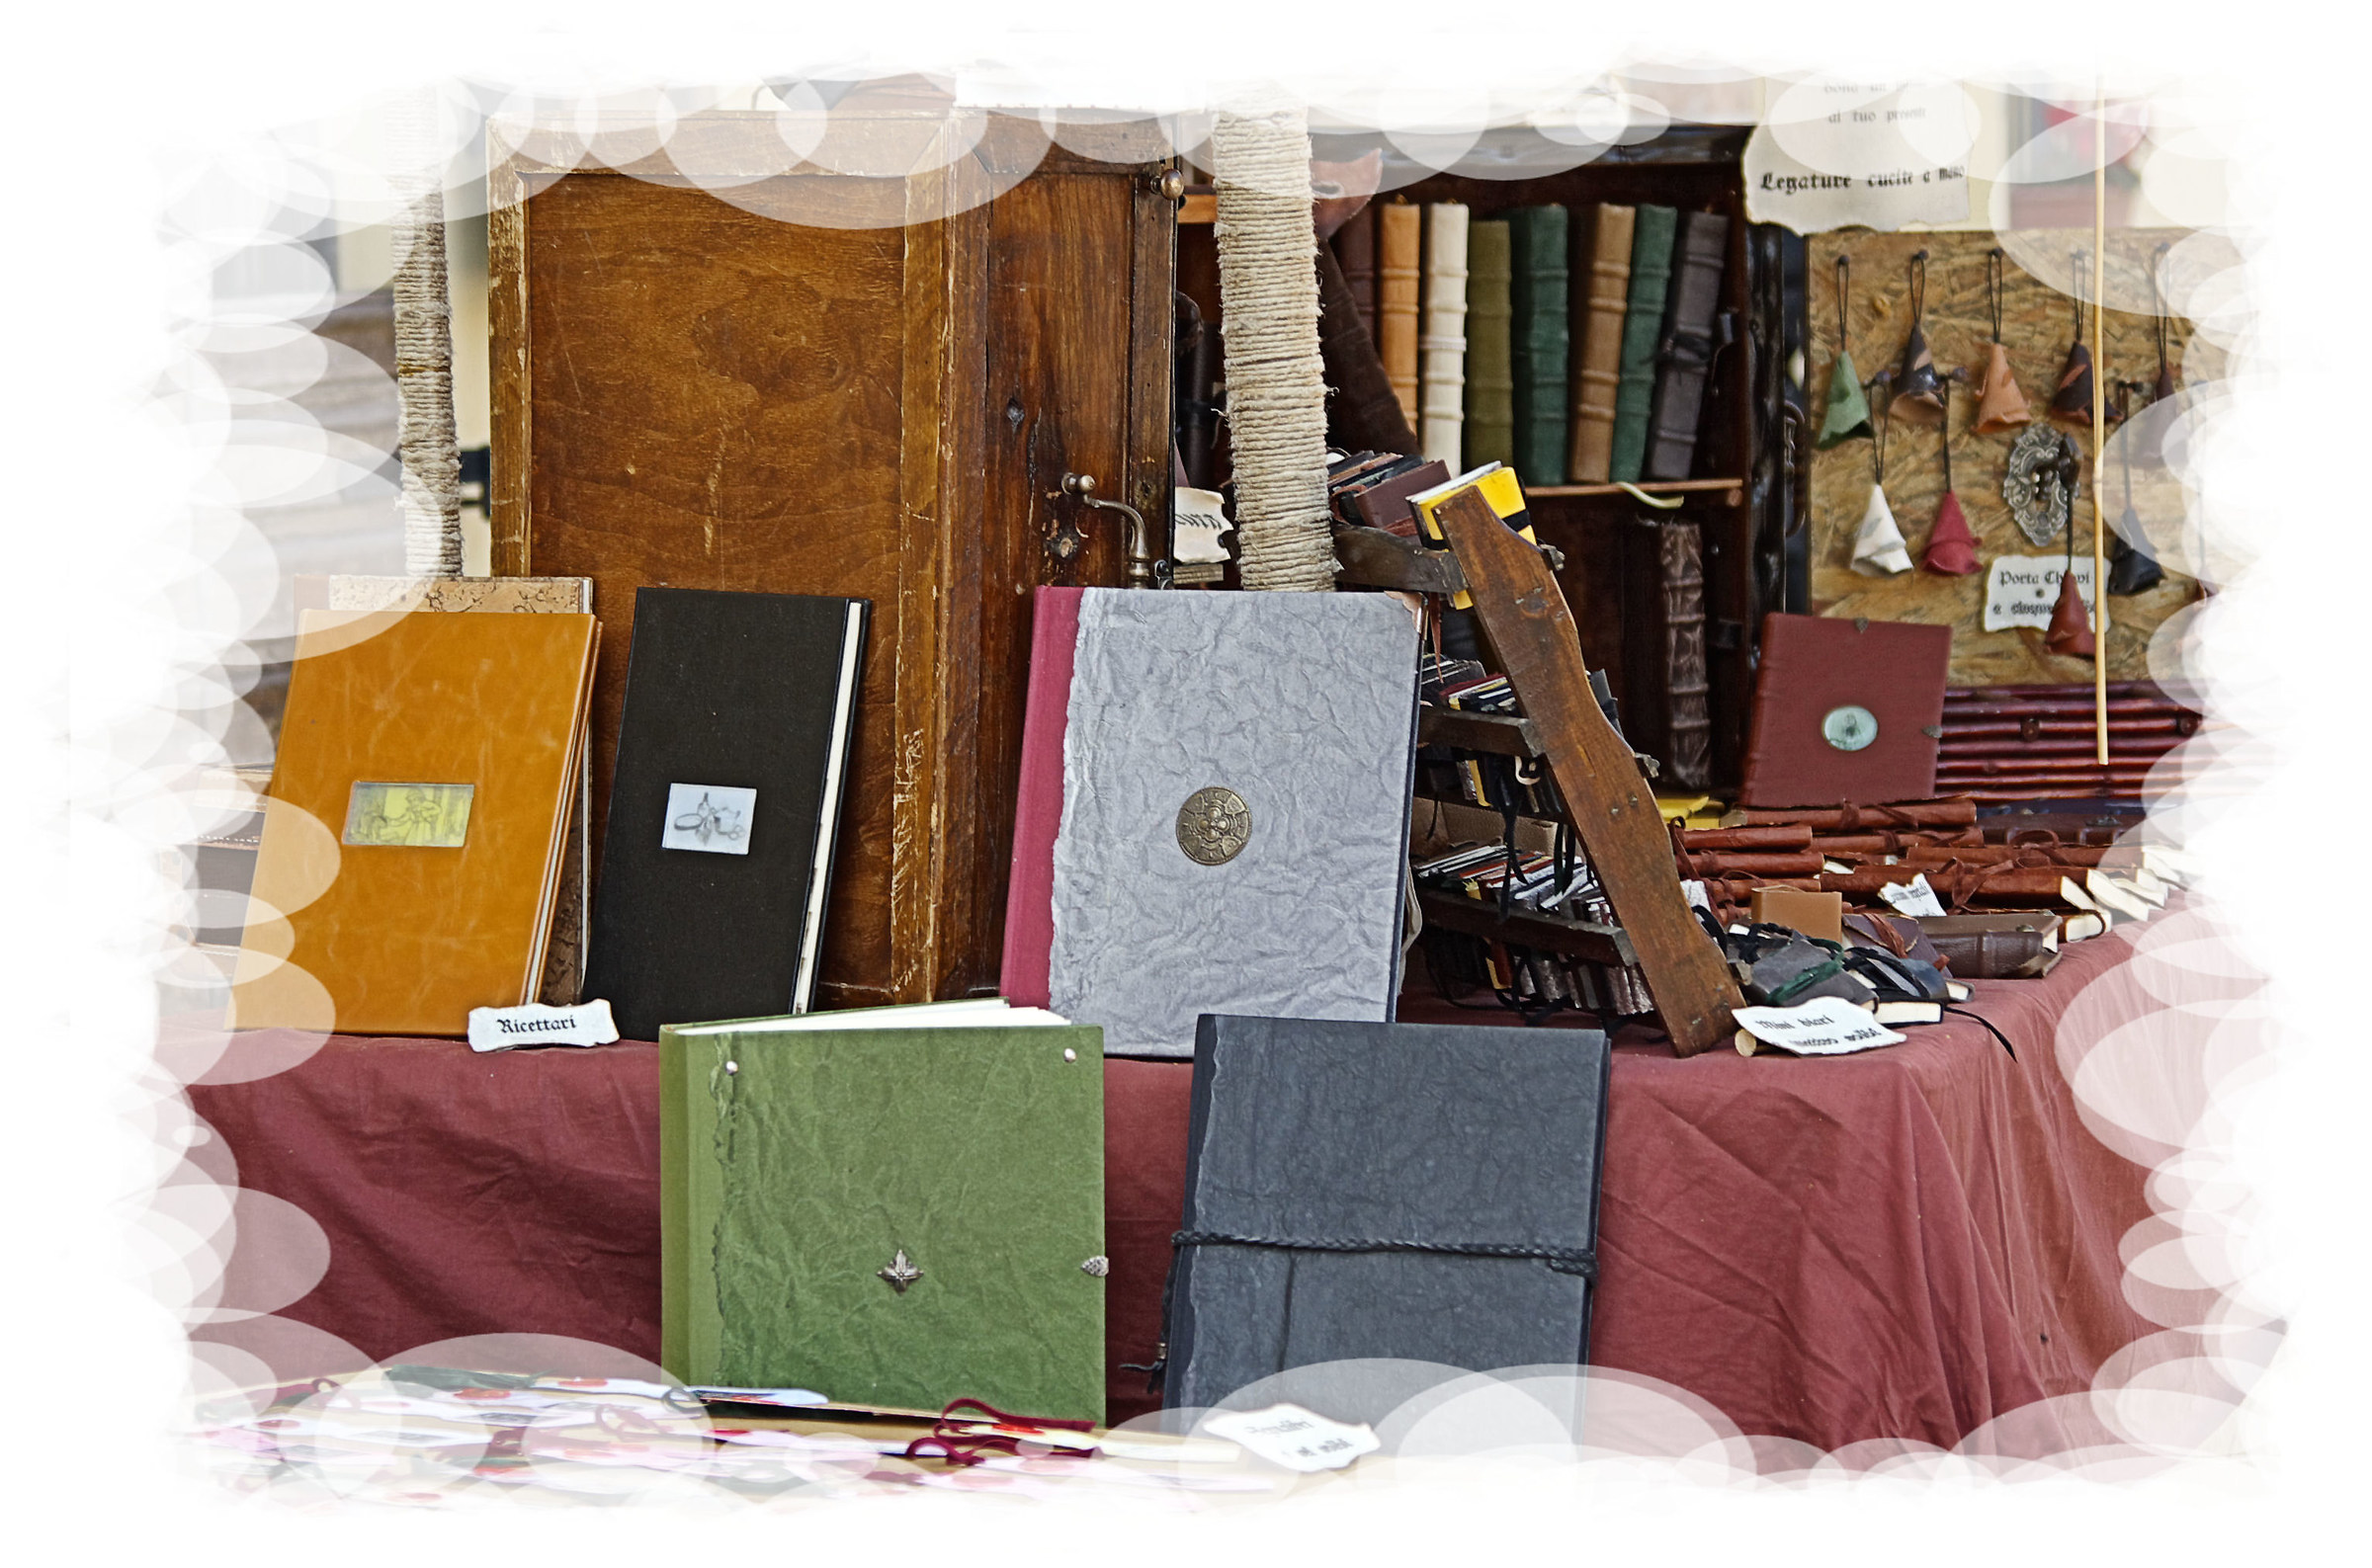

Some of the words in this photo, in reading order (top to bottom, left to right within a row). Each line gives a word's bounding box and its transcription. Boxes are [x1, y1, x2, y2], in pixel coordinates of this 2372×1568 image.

[1853, 110, 1876, 123] tuo
[1760, 171, 1851, 196] Legature
[1867, 168, 1913, 188] cucite
[1999, 570, 2039, 587] Porta
[2045, 570, 2089, 585] Chvi
[497, 1015, 576, 1033] Ricettari
